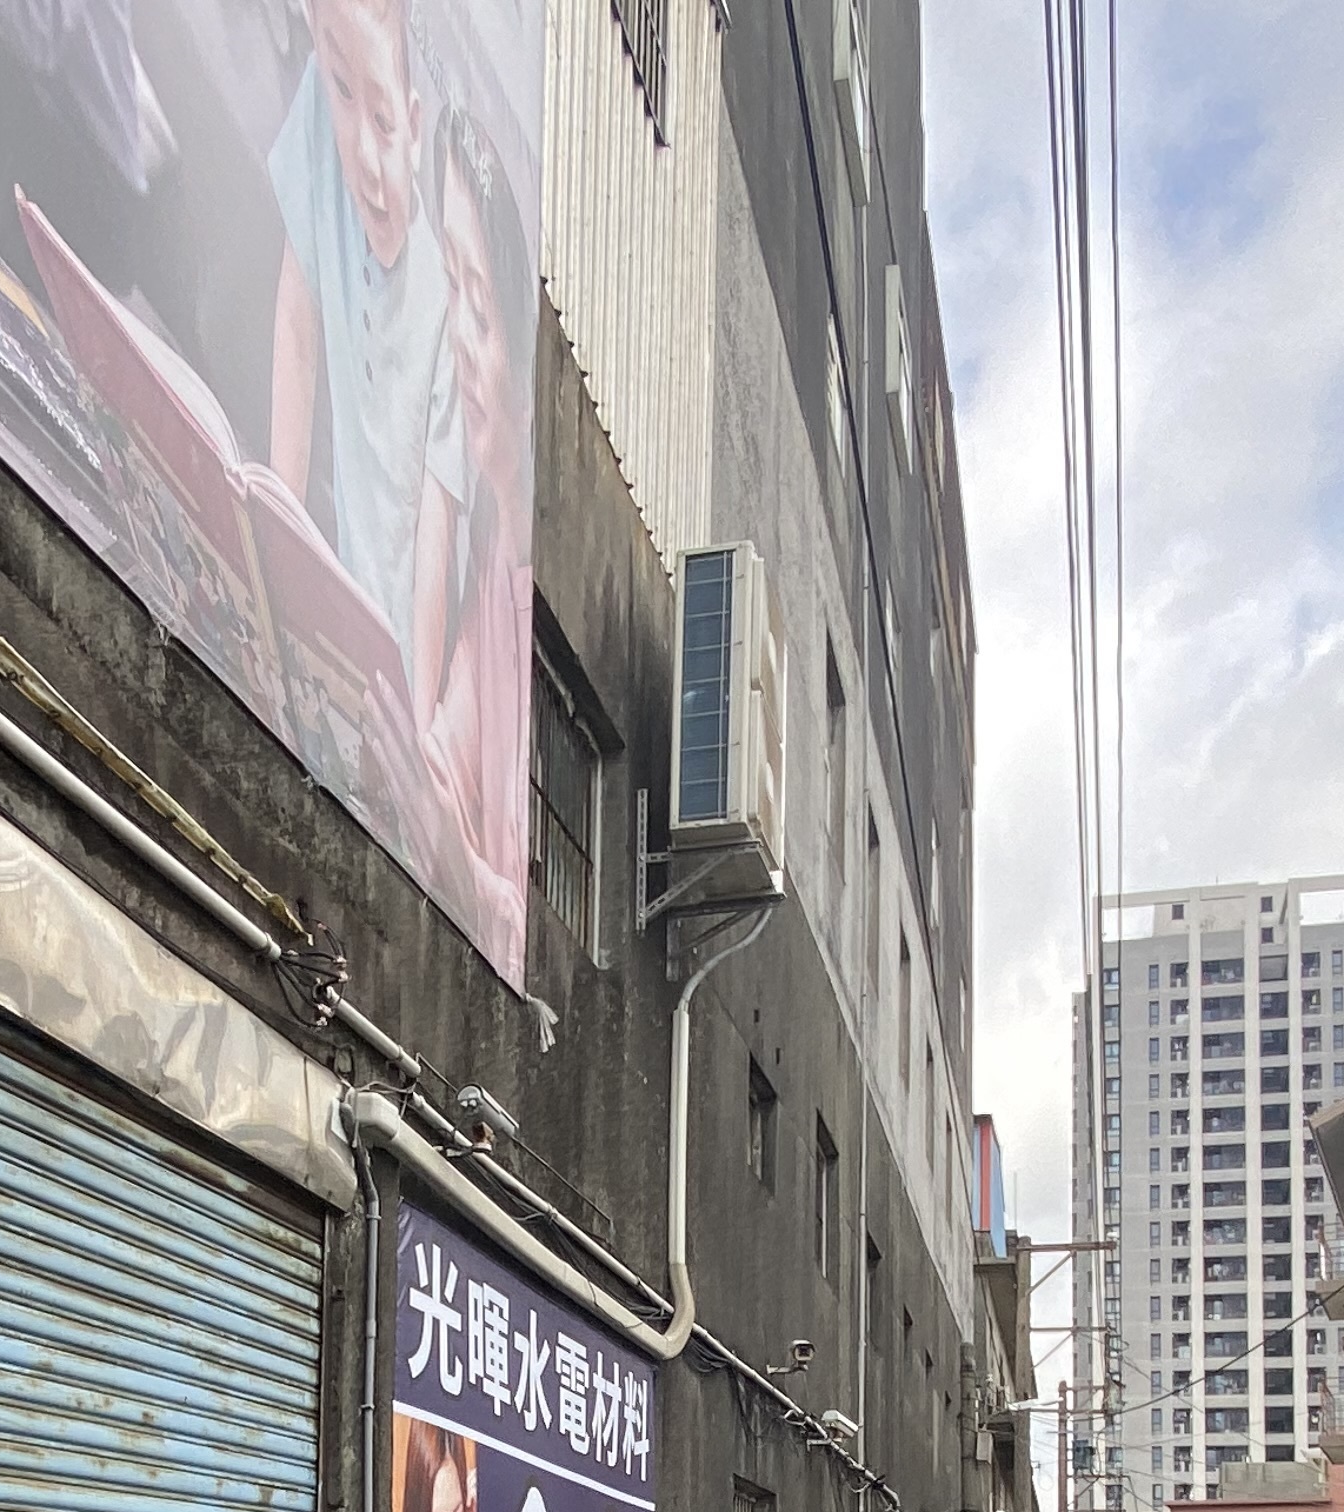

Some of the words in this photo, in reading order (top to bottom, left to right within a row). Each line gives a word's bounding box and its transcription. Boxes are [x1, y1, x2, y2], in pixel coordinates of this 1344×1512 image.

[407, 1242, 651, 1483] 光暉水電材料
